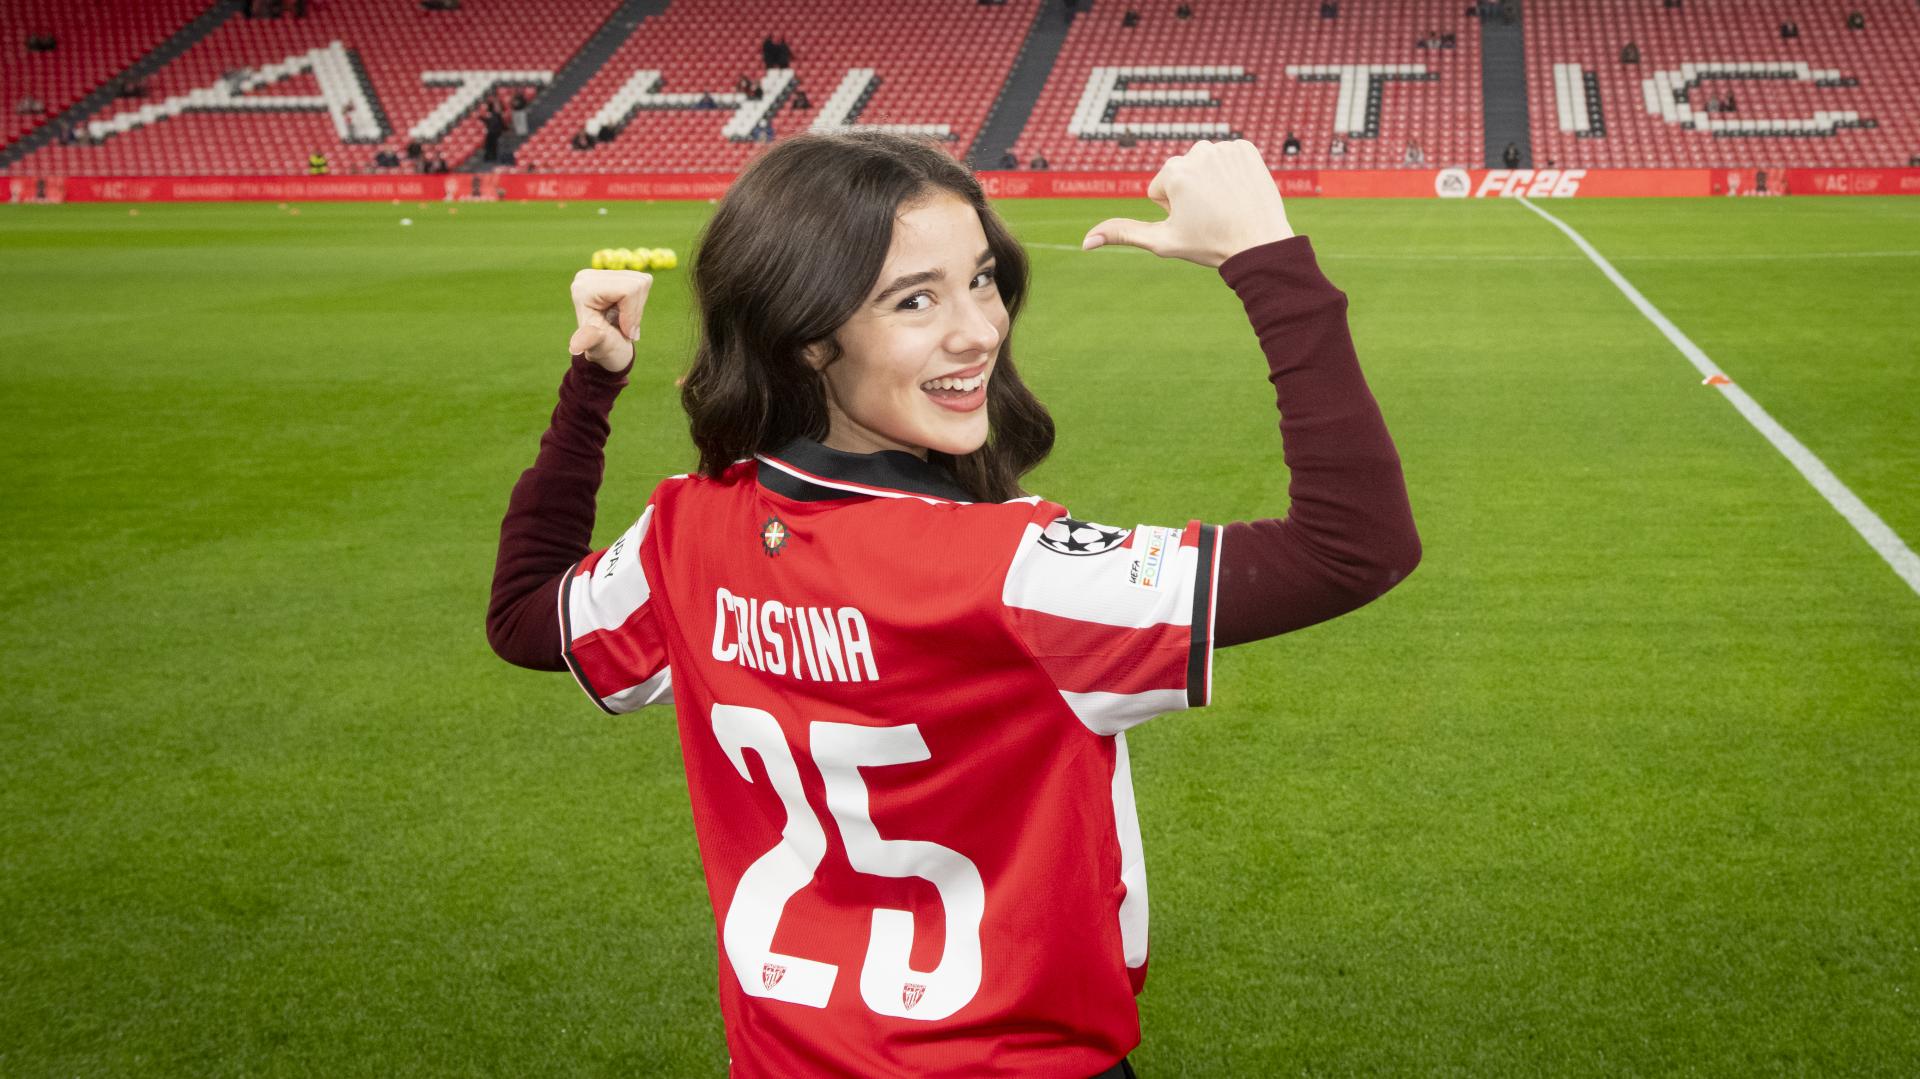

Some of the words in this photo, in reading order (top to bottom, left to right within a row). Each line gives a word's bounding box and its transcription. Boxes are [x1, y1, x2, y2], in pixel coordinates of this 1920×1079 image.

[88, 40, 1876, 141] ATHLETIC
[1129, 560, 1140, 584] UEFA
[712, 587, 880, 682] CRISTINA
[711, 702, 986, 1021] 25
